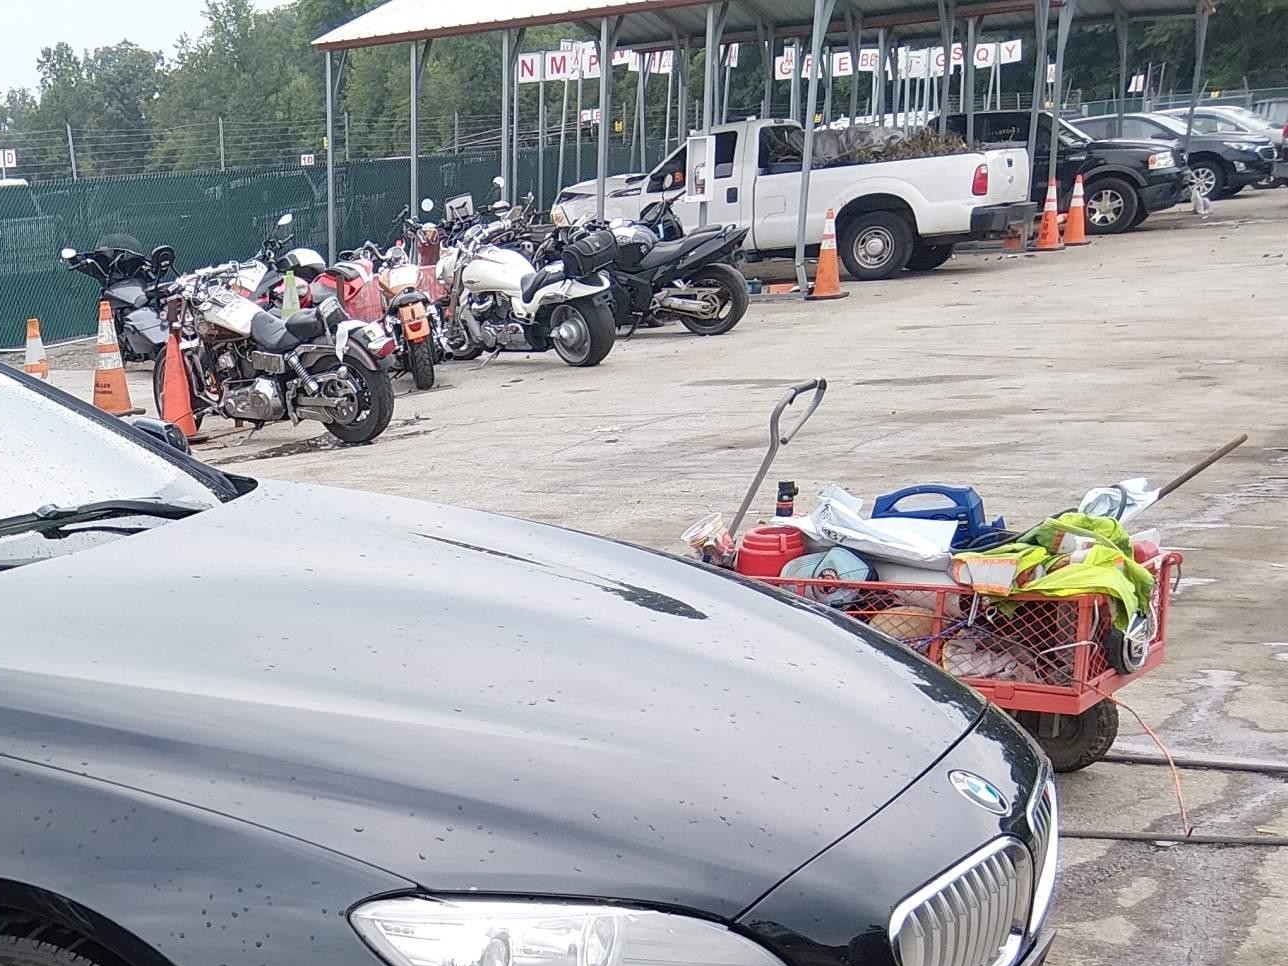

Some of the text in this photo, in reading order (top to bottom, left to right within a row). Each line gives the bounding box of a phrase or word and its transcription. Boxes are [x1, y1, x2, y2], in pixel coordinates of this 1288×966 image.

[952, 46, 964, 61] S
[975, 47, 990, 62] Q
[1005, 44, 1016, 59] Y
[520, 58, 535, 78] N
[550, 55, 567, 75] M
[838, 56, 849, 72] E
